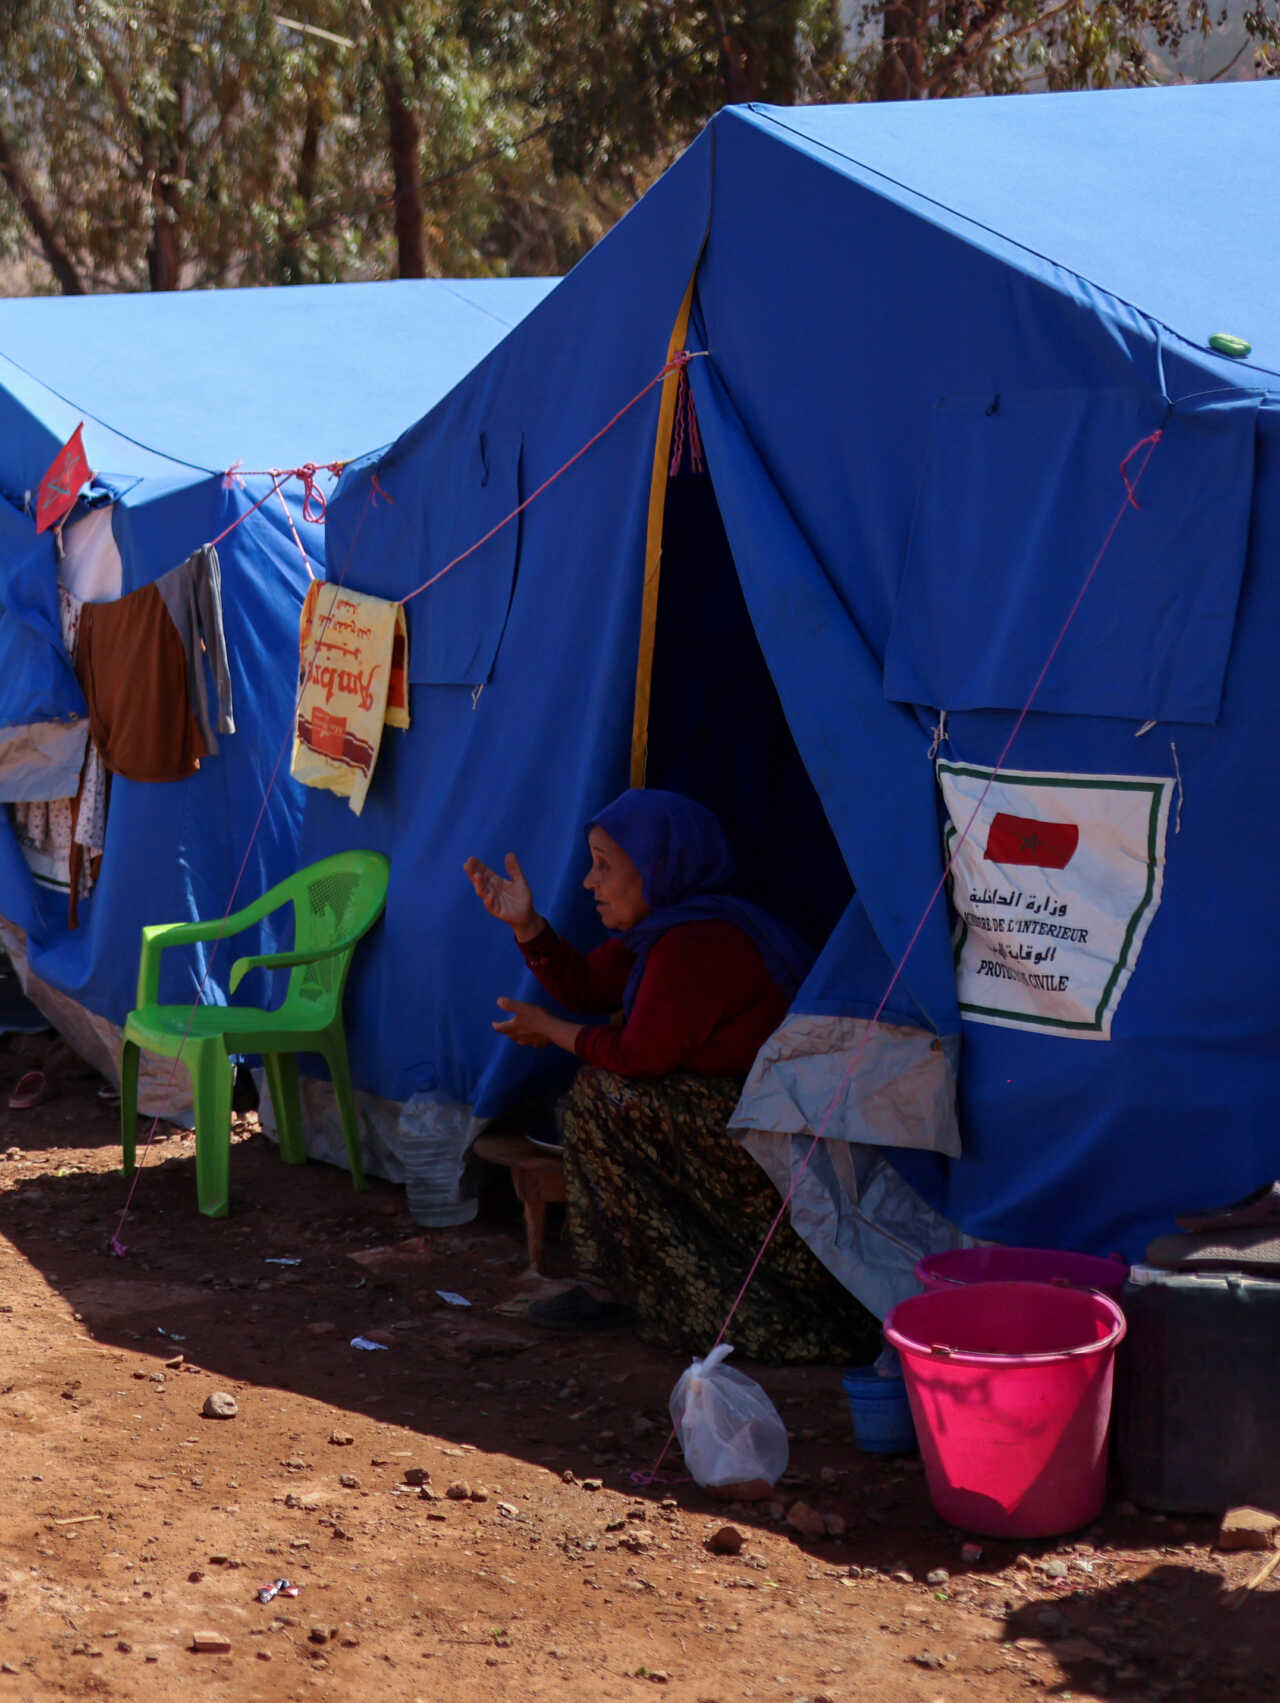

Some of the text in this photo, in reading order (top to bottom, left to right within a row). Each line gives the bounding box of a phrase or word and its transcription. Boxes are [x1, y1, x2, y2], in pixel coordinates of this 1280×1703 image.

[969, 888, 1068, 917] وزارة الداخلية
[993, 918, 1004, 932] DE
[1007, 919, 1089, 943] L'INTERIEUR
